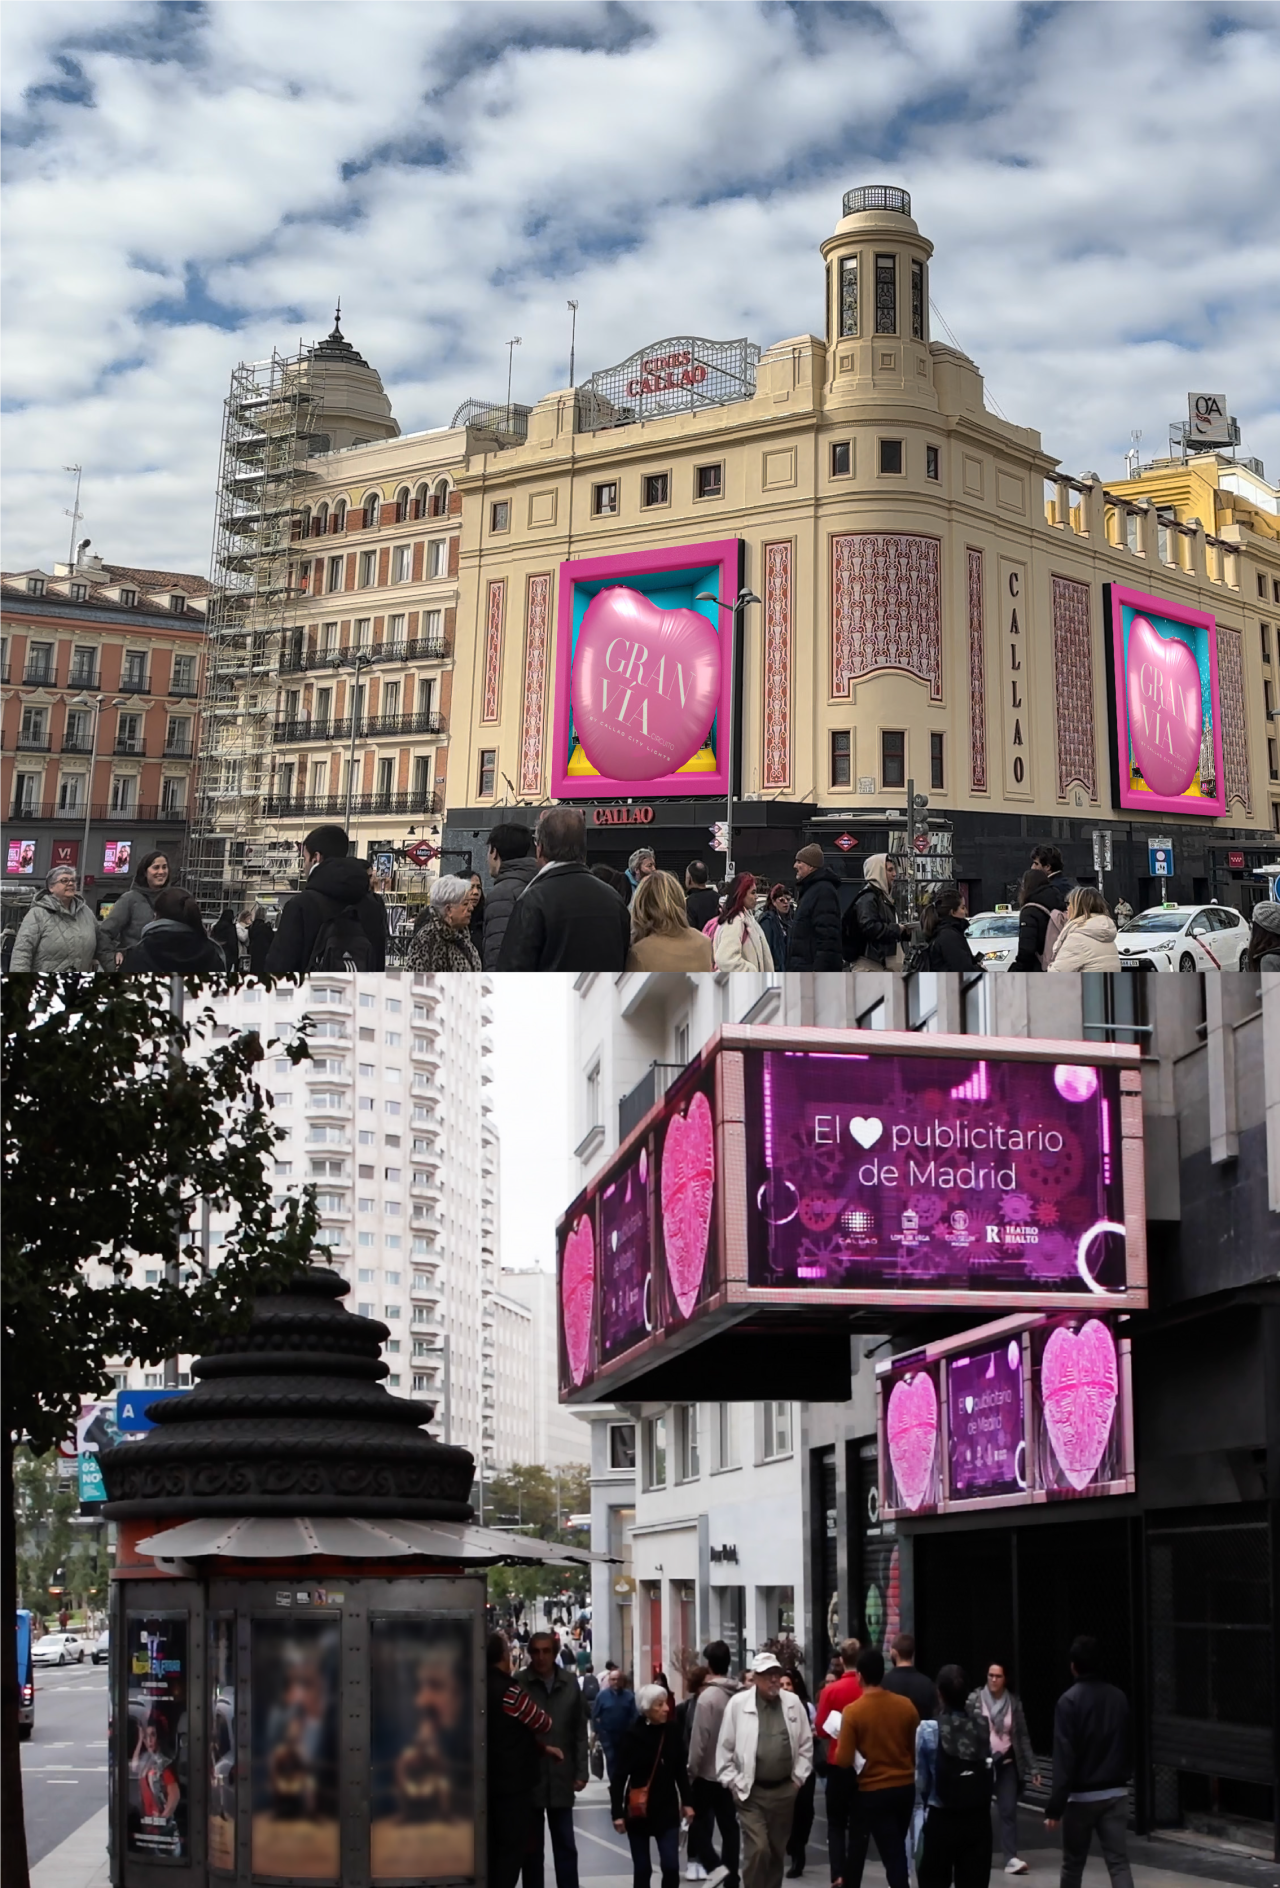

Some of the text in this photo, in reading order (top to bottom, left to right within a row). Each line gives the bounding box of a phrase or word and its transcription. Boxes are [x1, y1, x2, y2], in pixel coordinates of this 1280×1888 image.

[642, 350, 691, 373] CINES
[626, 365, 706, 398] CALLAO
[605, 637, 697, 709] GRAN
[1009, 572, 1025, 783] CALLAO
[600, 677, 651, 738] VÍA
[1140, 663, 1189, 726] GRAN
[1140, 703, 1174, 755] VÍA
[593, 806, 655, 825] CALLAO
[814, 1115, 1063, 1152] El publicitario
[858, 1158, 1016, 1190] de Madrid
[839, 1237, 878, 1245] CALLAO
[985, 1225, 1000, 1243] R
[1005, 1226, 1038, 1235] TEATRO
[1005, 1235, 1038, 1244] RIALTO
[122, 1404, 135, 1418] A
